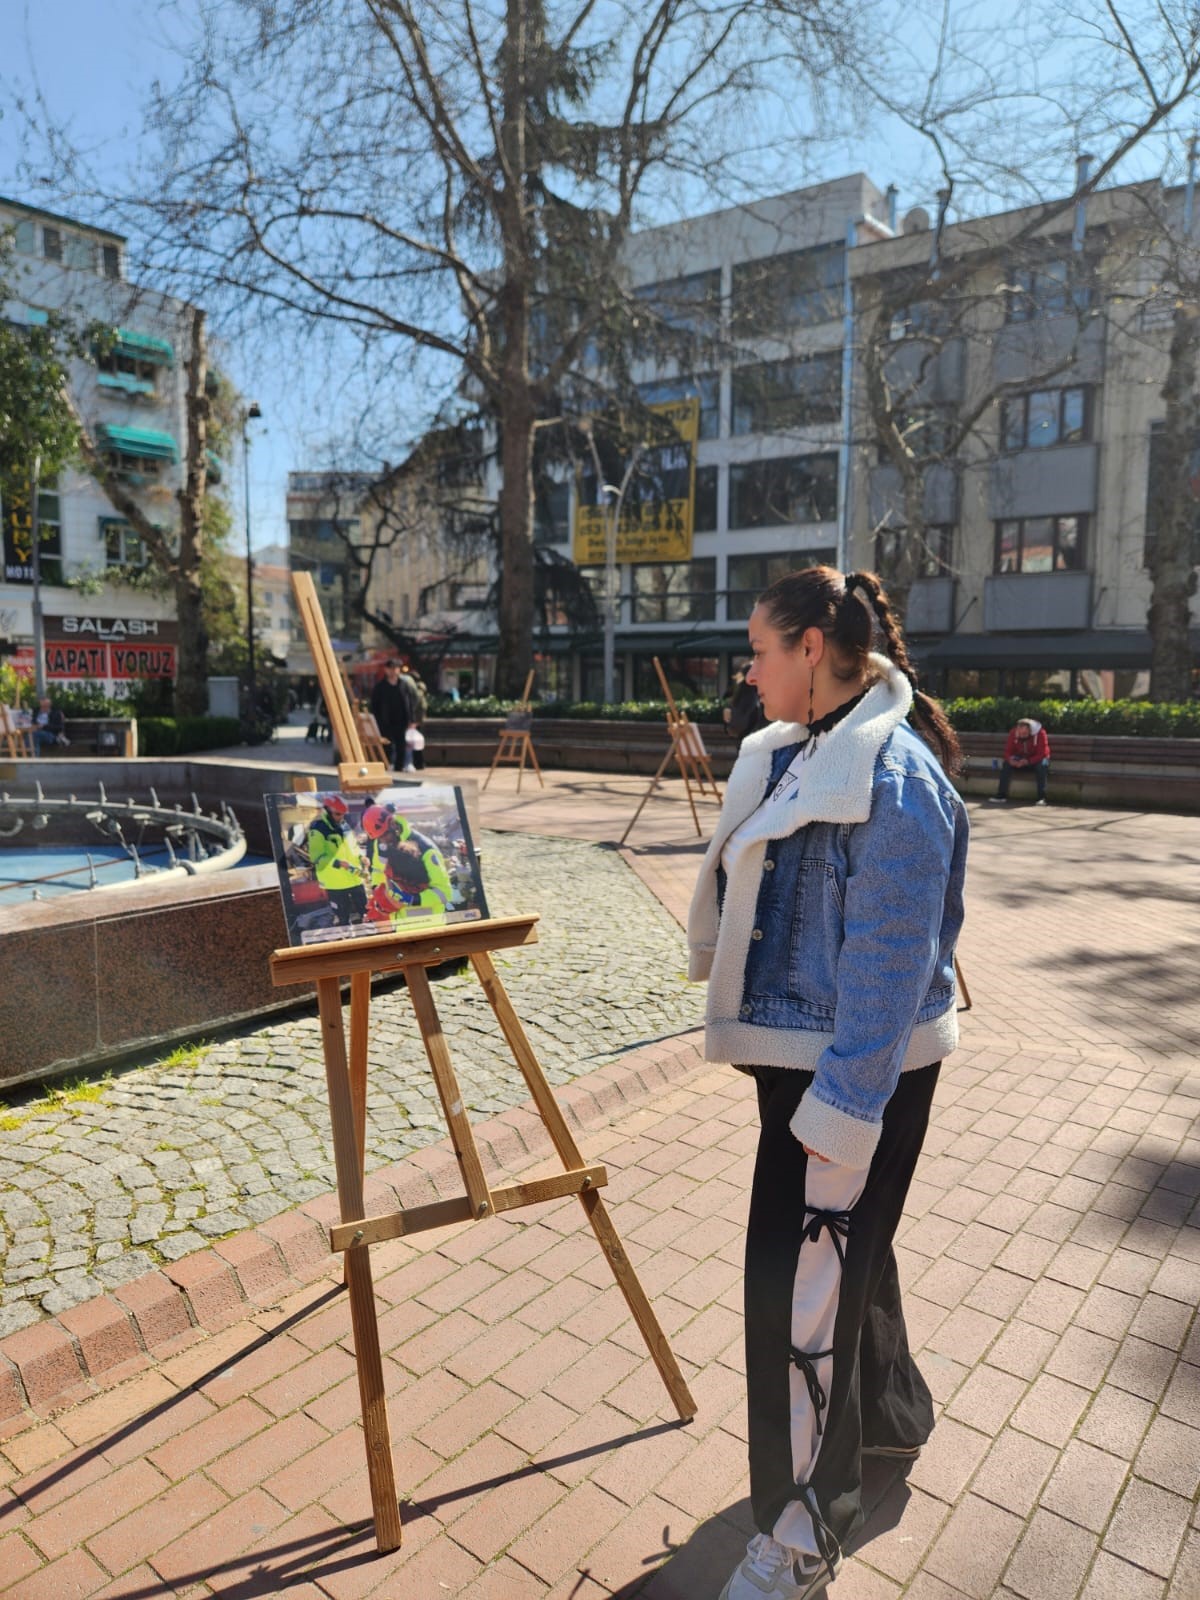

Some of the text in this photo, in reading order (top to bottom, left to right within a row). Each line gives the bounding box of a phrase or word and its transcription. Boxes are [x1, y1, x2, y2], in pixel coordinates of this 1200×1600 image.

[62, 616, 158, 635] SALASH
[45, 647, 173, 674] KAPATI YORUZ
